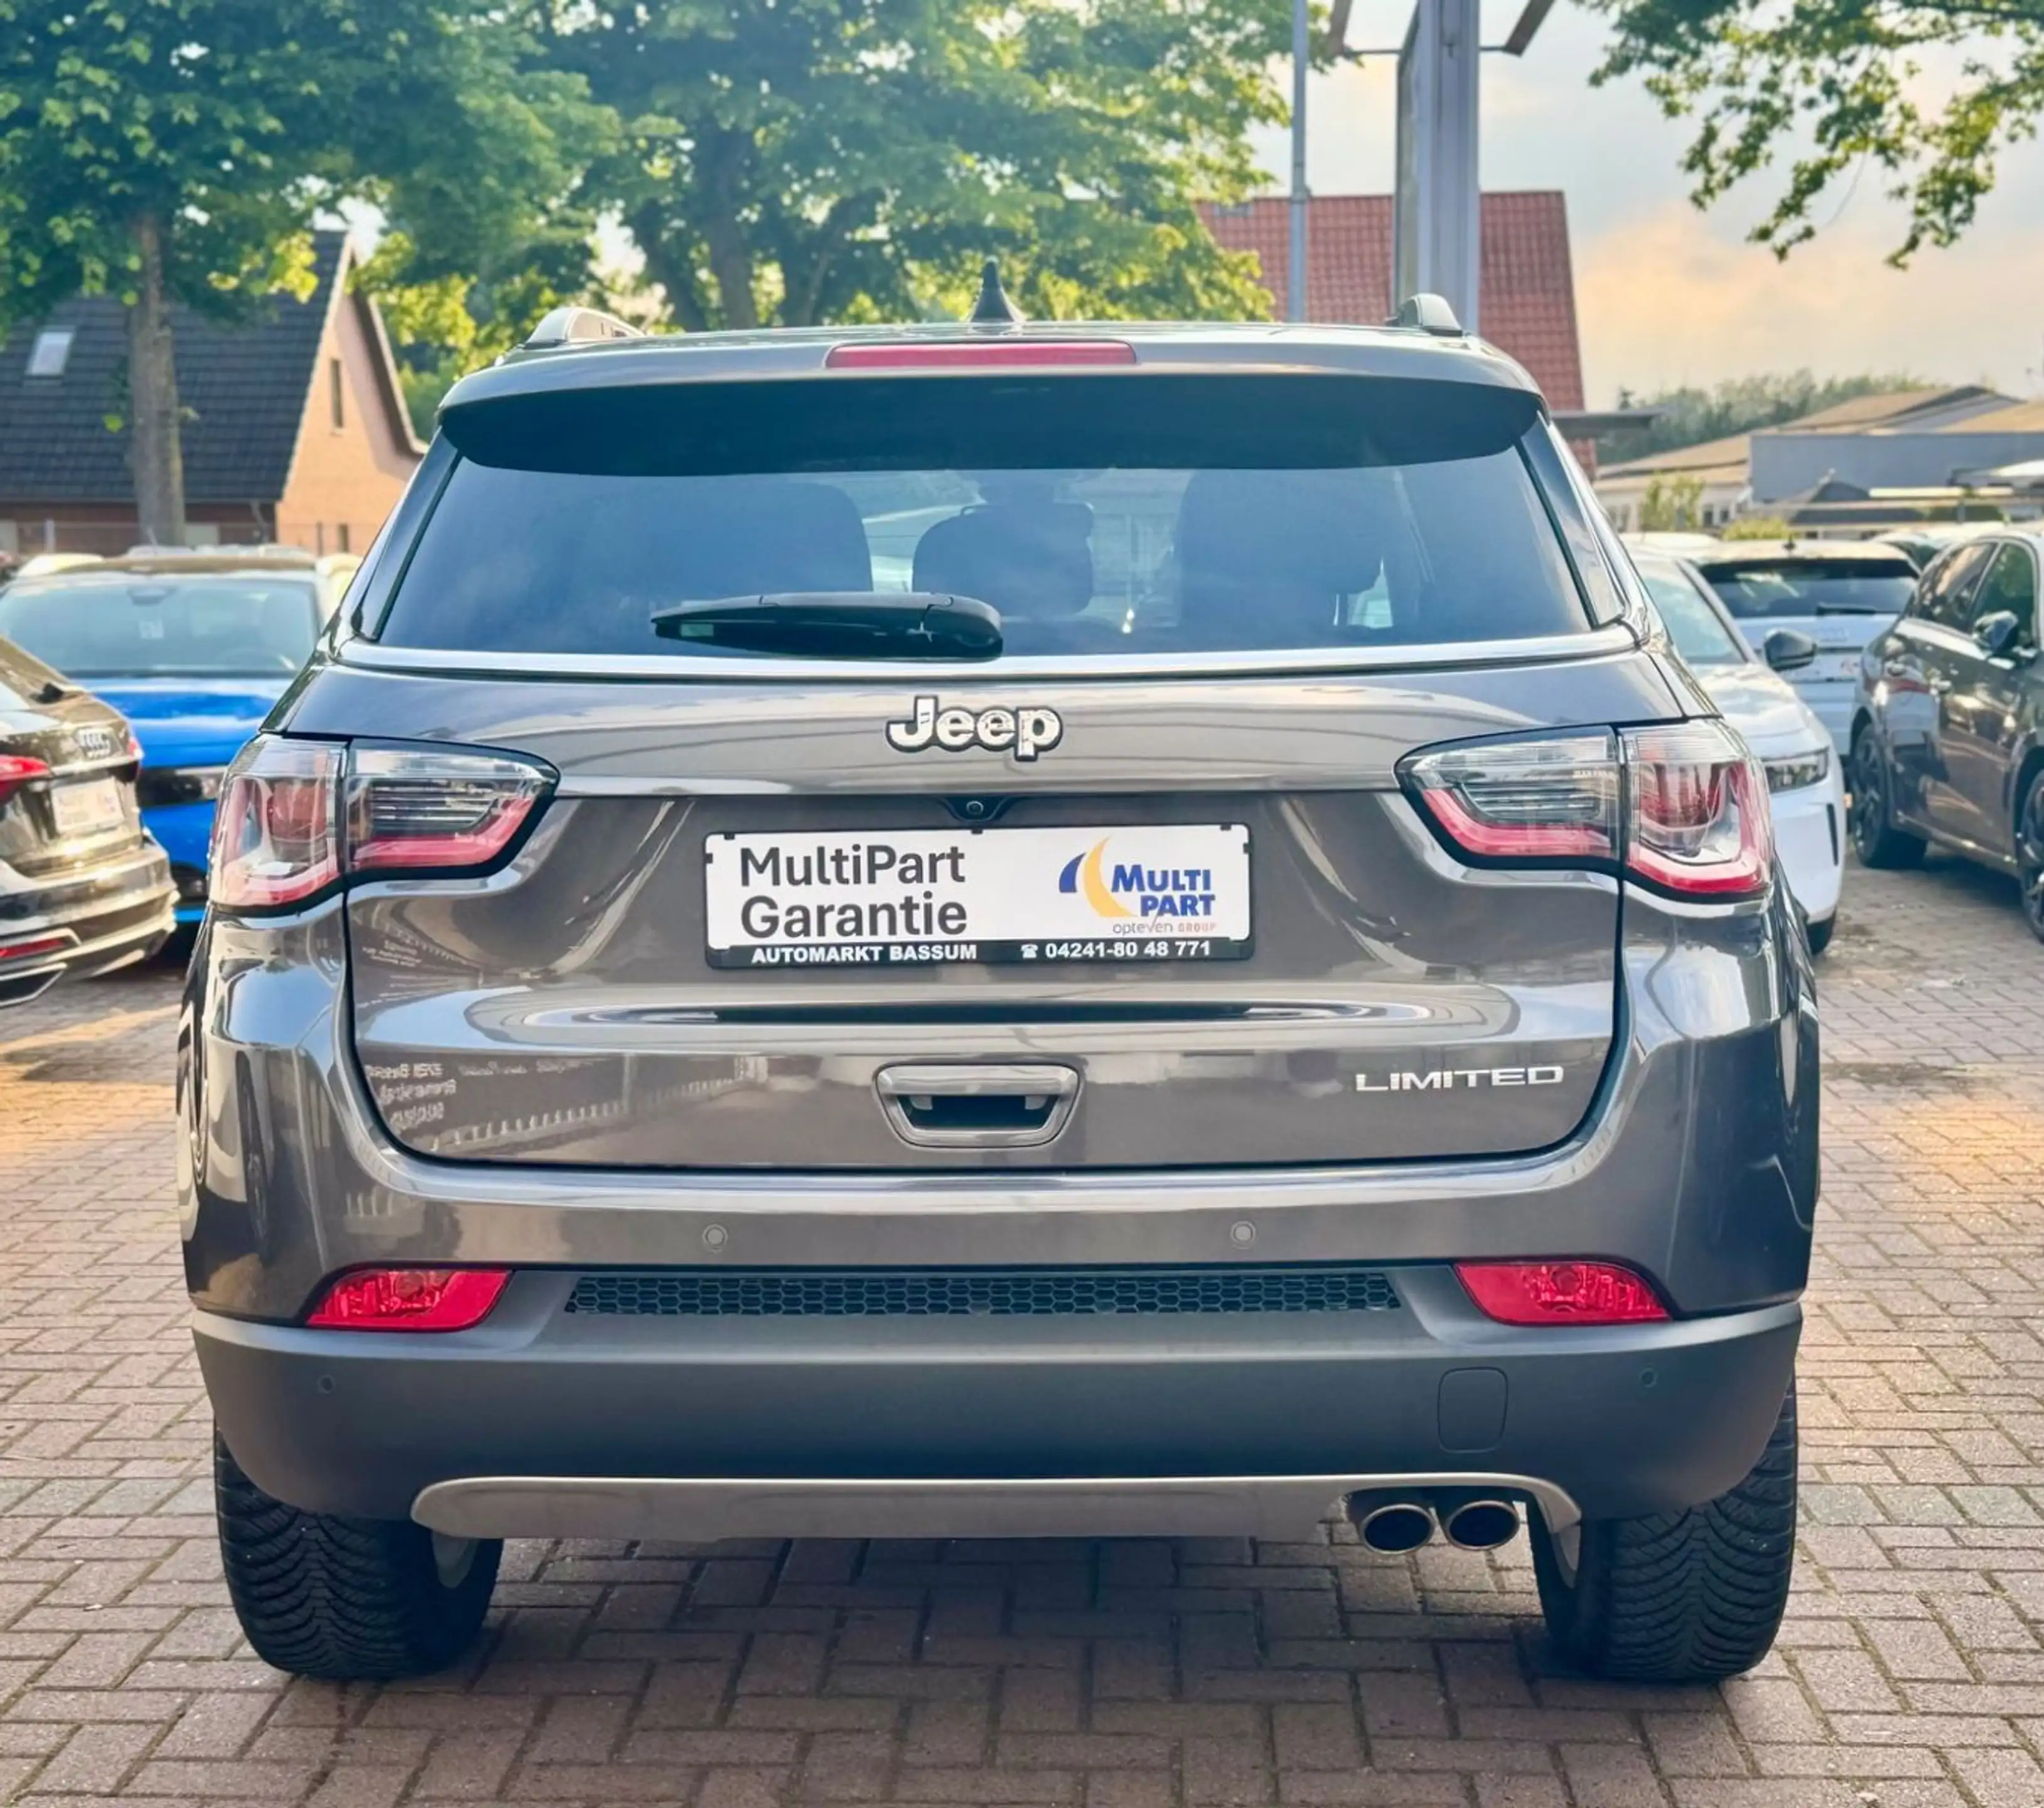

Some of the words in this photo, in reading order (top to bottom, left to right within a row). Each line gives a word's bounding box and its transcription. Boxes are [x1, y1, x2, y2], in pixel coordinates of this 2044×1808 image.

[886, 695, 1063, 761] Jeep
[740, 844, 966, 887] MultiPart
[741, 891, 967, 938] Garantie
[1140, 895, 1216, 917] PART
[751, 946, 883, 964] AUTOMARKT
[889, 944, 977, 960] BASSUM
[1045, 942, 1138, 959] 04241-80
[1143, 942, 1170, 957] 48
[1175, 940, 1210, 956] 771
[1355, 1065, 1564, 1092] LIMITED
